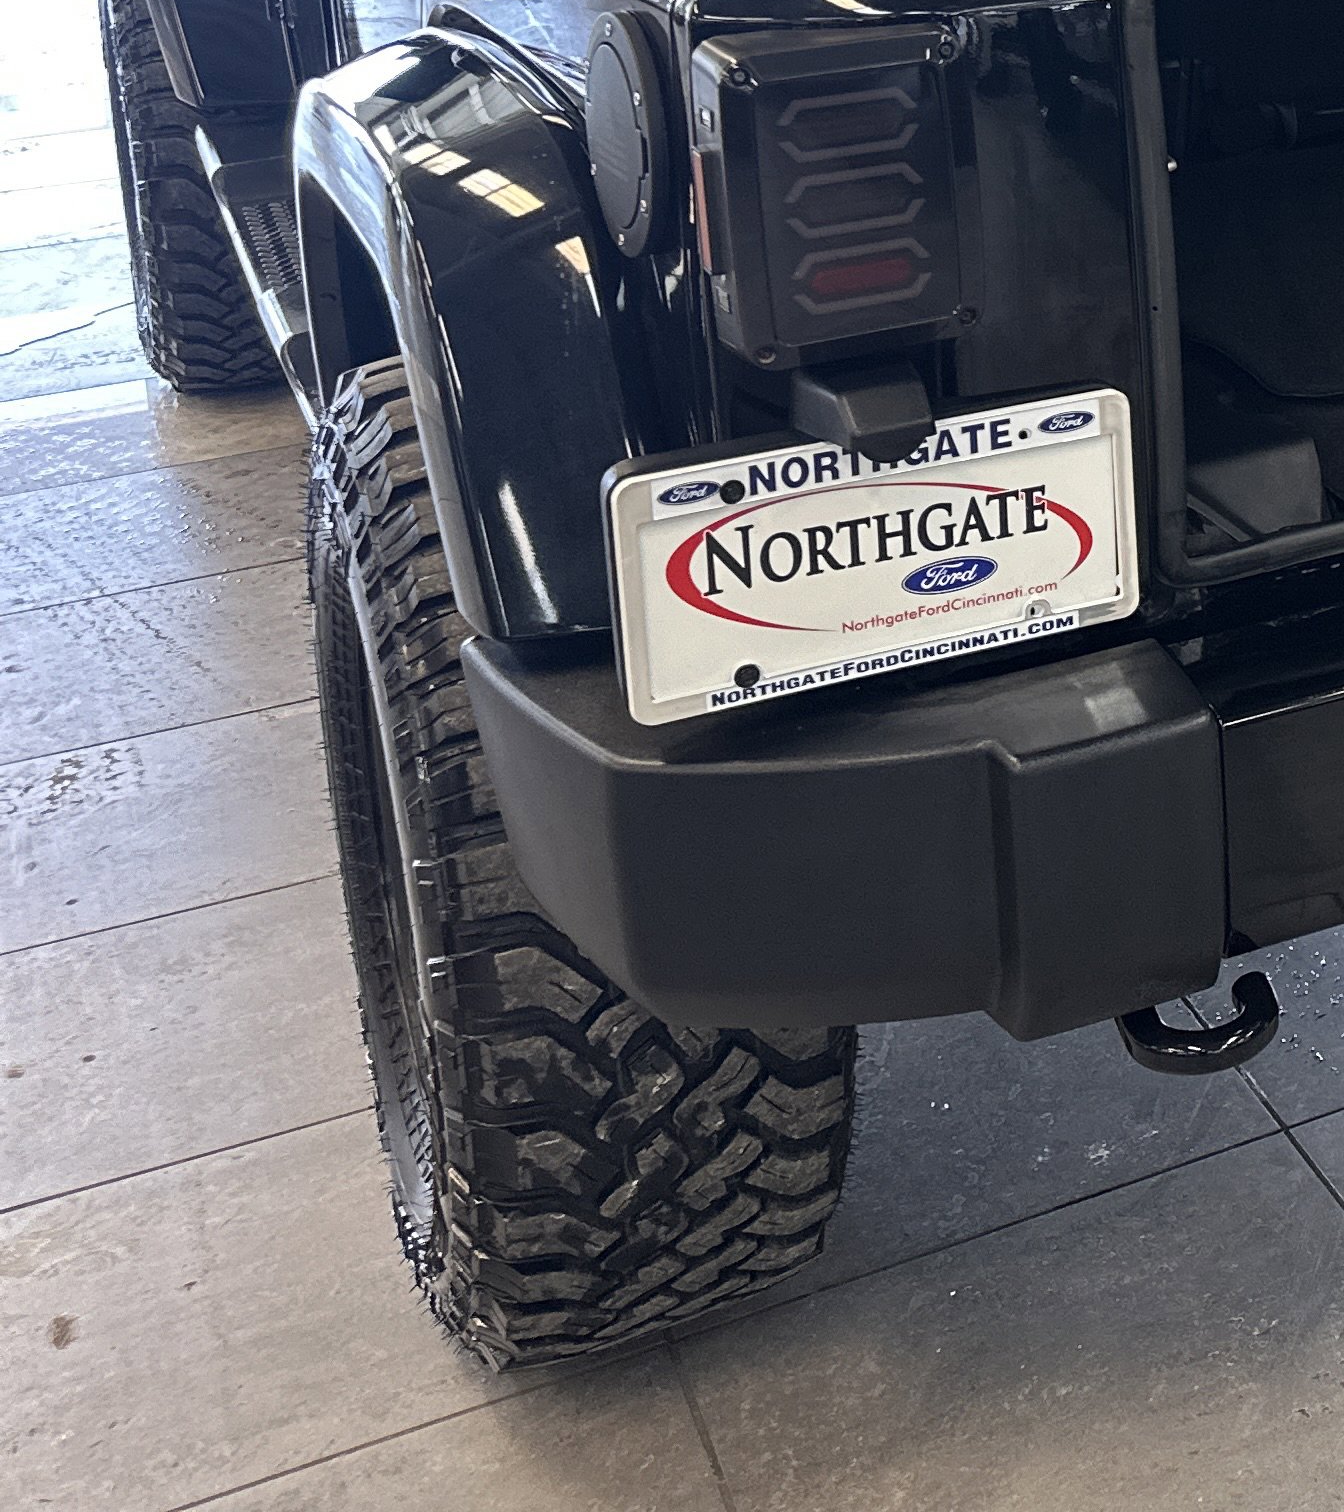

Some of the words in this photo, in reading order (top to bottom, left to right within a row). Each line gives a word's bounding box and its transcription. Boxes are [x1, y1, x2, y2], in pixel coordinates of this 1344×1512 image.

[668, 485, 707, 503] Ford
[1048, 413, 1084, 431] Ford
[702, 484, 1049, 597] NORTHGATE
[919, 563, 978, 590] Ford
[841, 581, 1058, 634] NorthgateFordCincinnati.com
[711, 615, 1075, 707] NORTHGATEFORDCINCINNATI.COM
